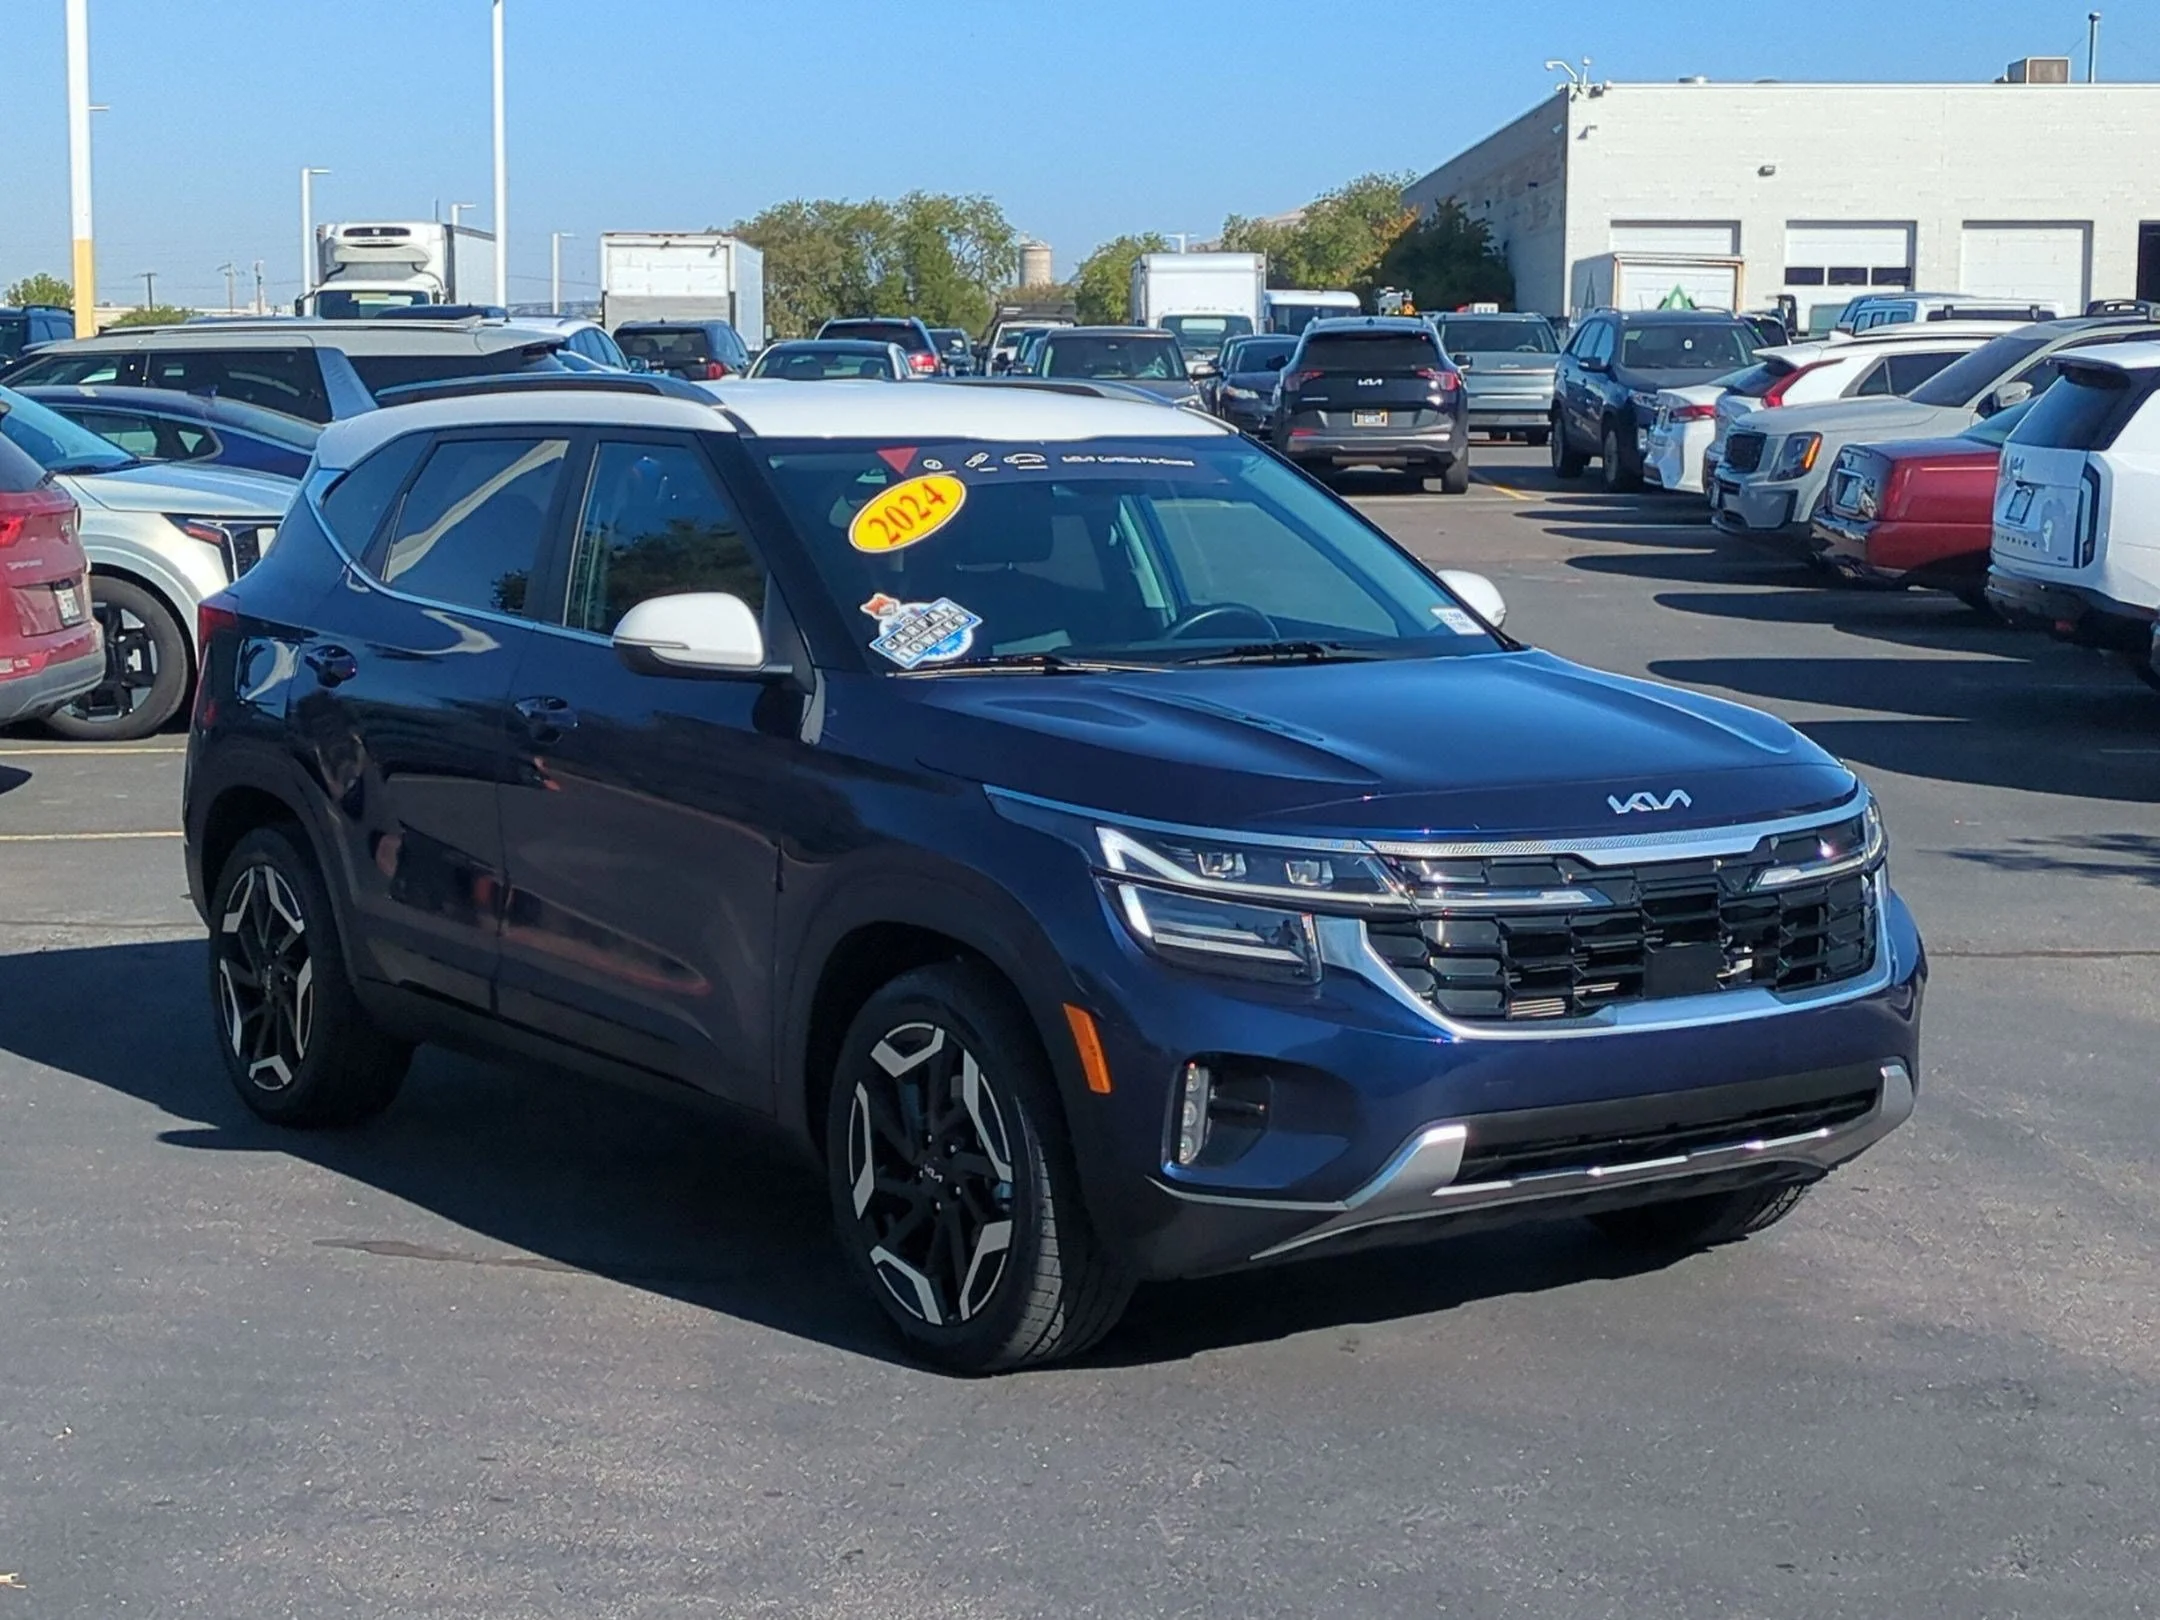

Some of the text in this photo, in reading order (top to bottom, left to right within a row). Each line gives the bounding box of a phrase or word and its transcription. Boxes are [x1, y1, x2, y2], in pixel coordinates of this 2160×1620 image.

[868, 482, 946, 545] 2024
[882, 606, 954, 652] CARFAX
[1607, 789, 1692, 814] KIA
